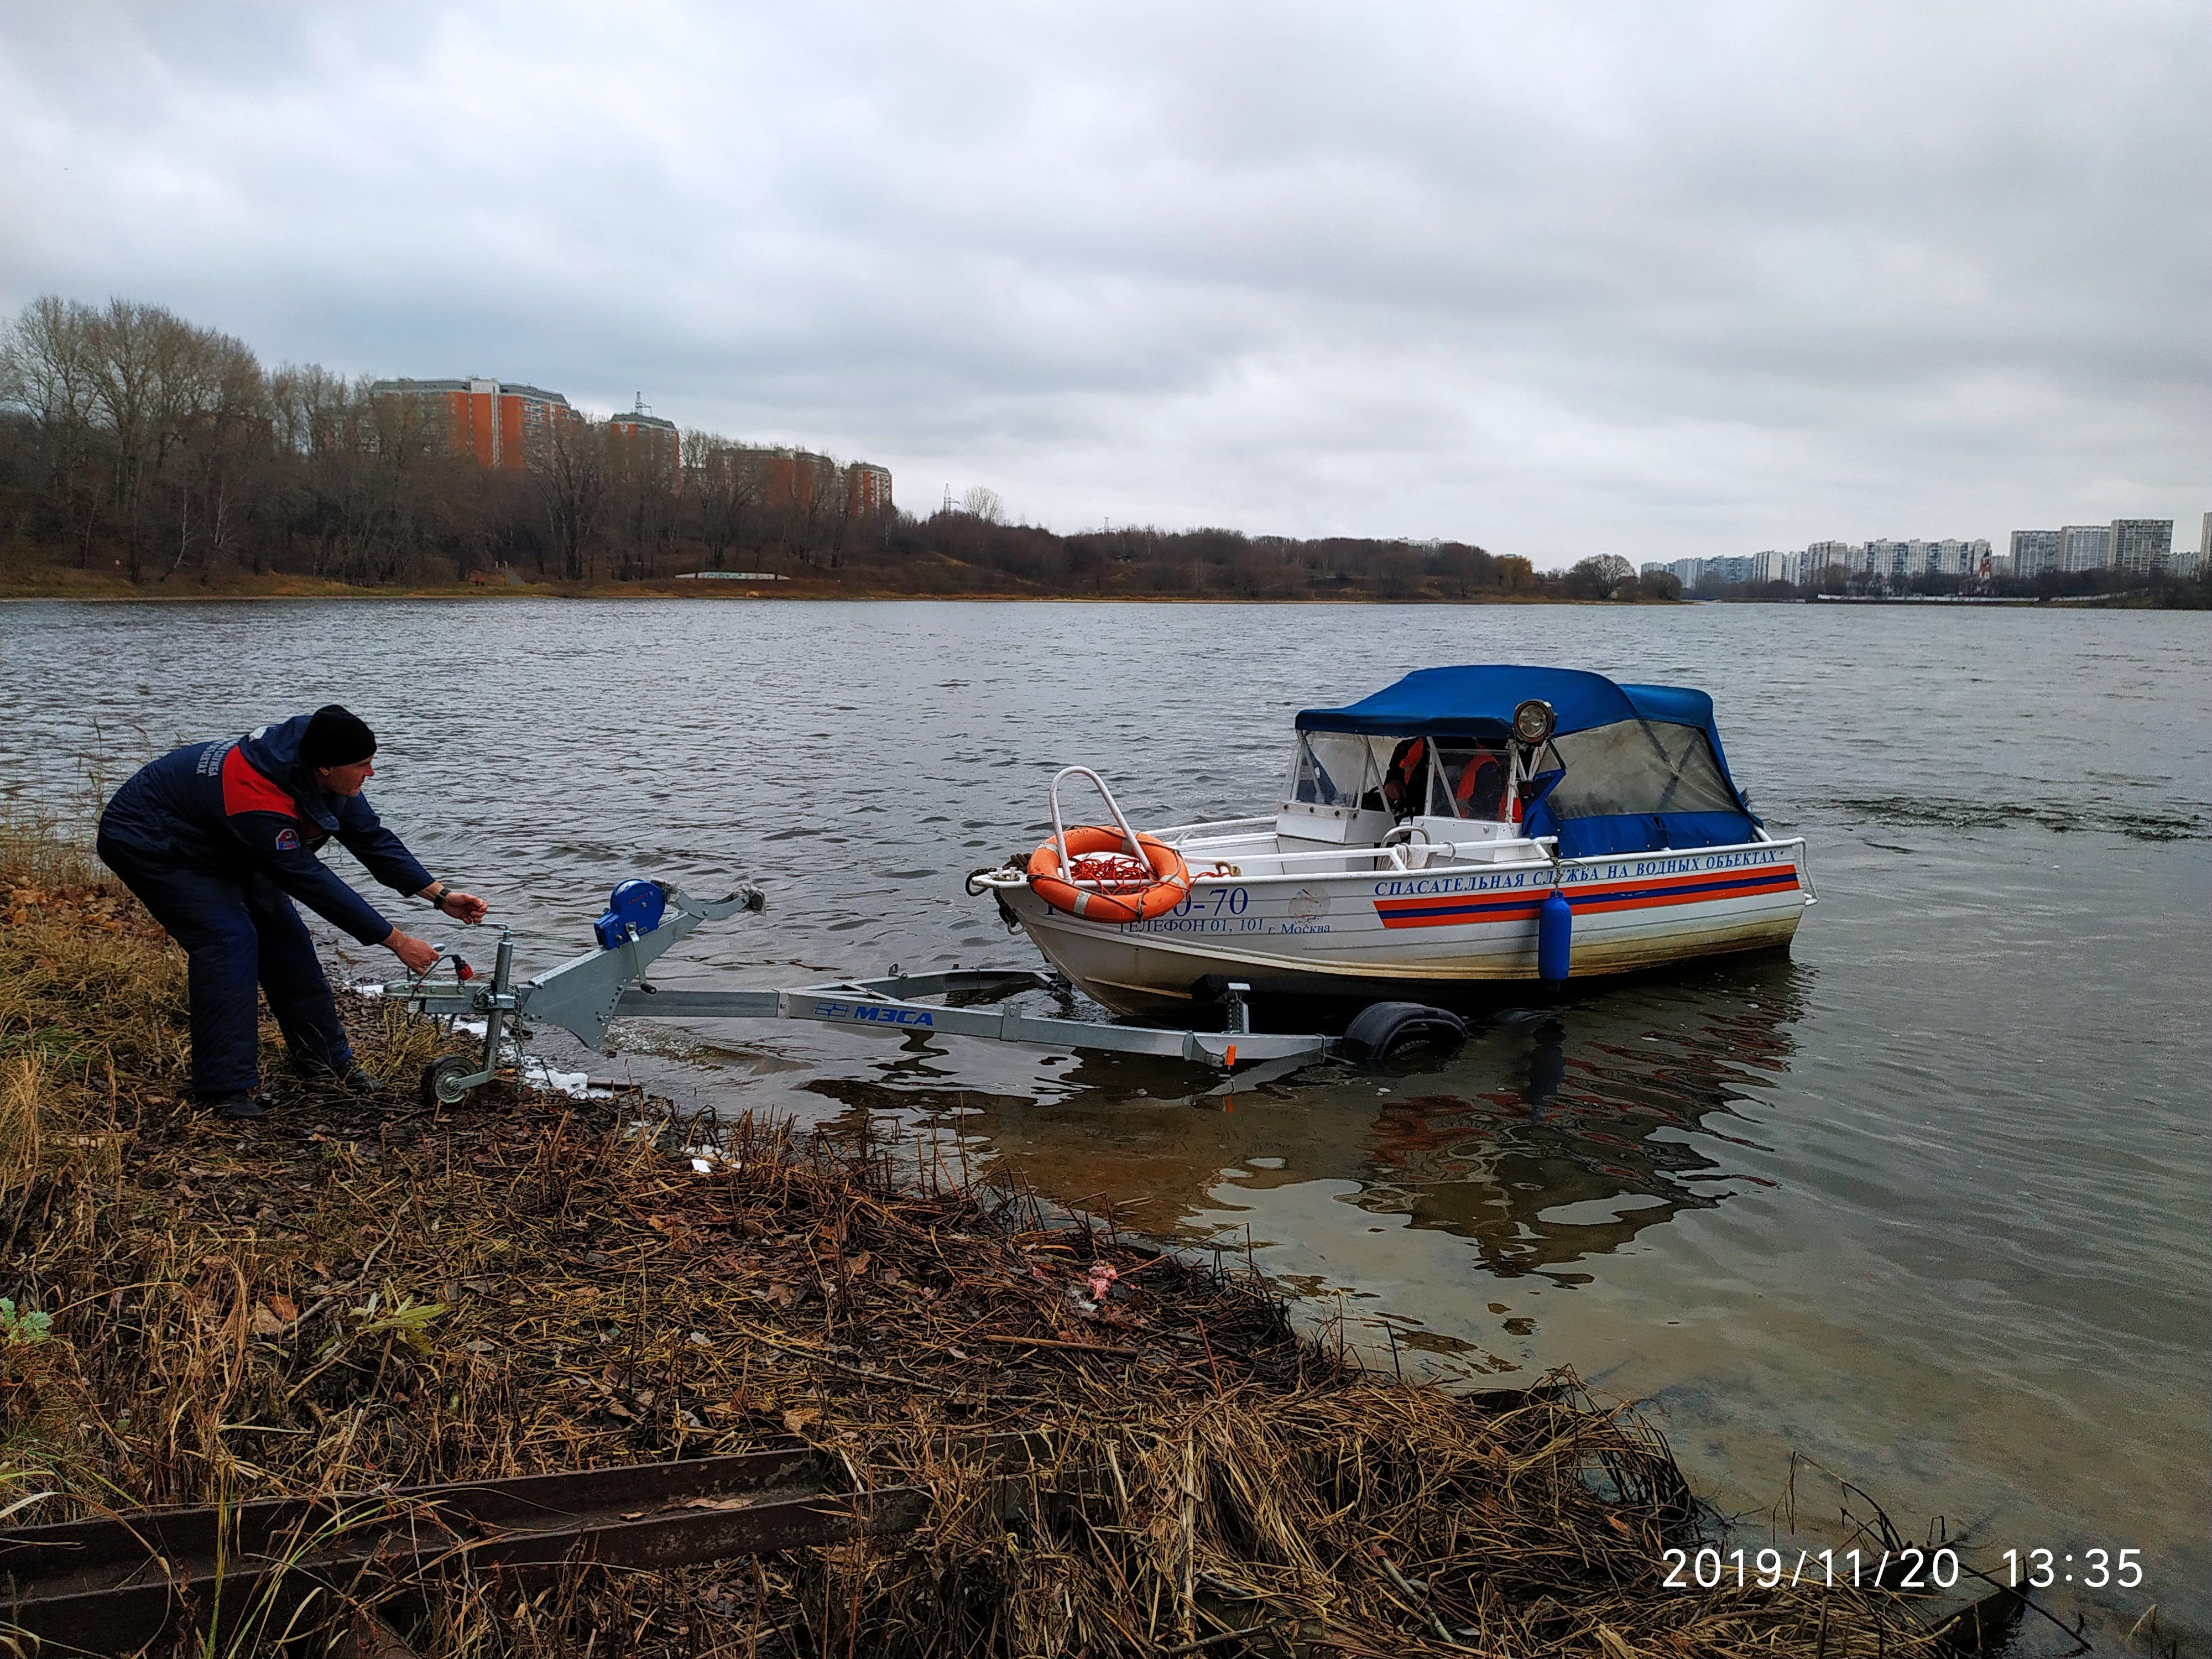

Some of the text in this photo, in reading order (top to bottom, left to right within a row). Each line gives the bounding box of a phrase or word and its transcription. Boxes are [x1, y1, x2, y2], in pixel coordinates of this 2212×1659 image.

[1374, 873, 1525, 896] СПАСАТЕЛЬНАЯ
[1606, 865, 1628, 879] НА
[1636, 857, 1700, 875] ВОДНЫХ
[1705, 850, 1777, 869] ОБЪЕКТАХ
[1211, 919, 1233, 933] 01,
[1240, 918, 1263, 931] 101
[1281, 923, 1330, 935] Москва
